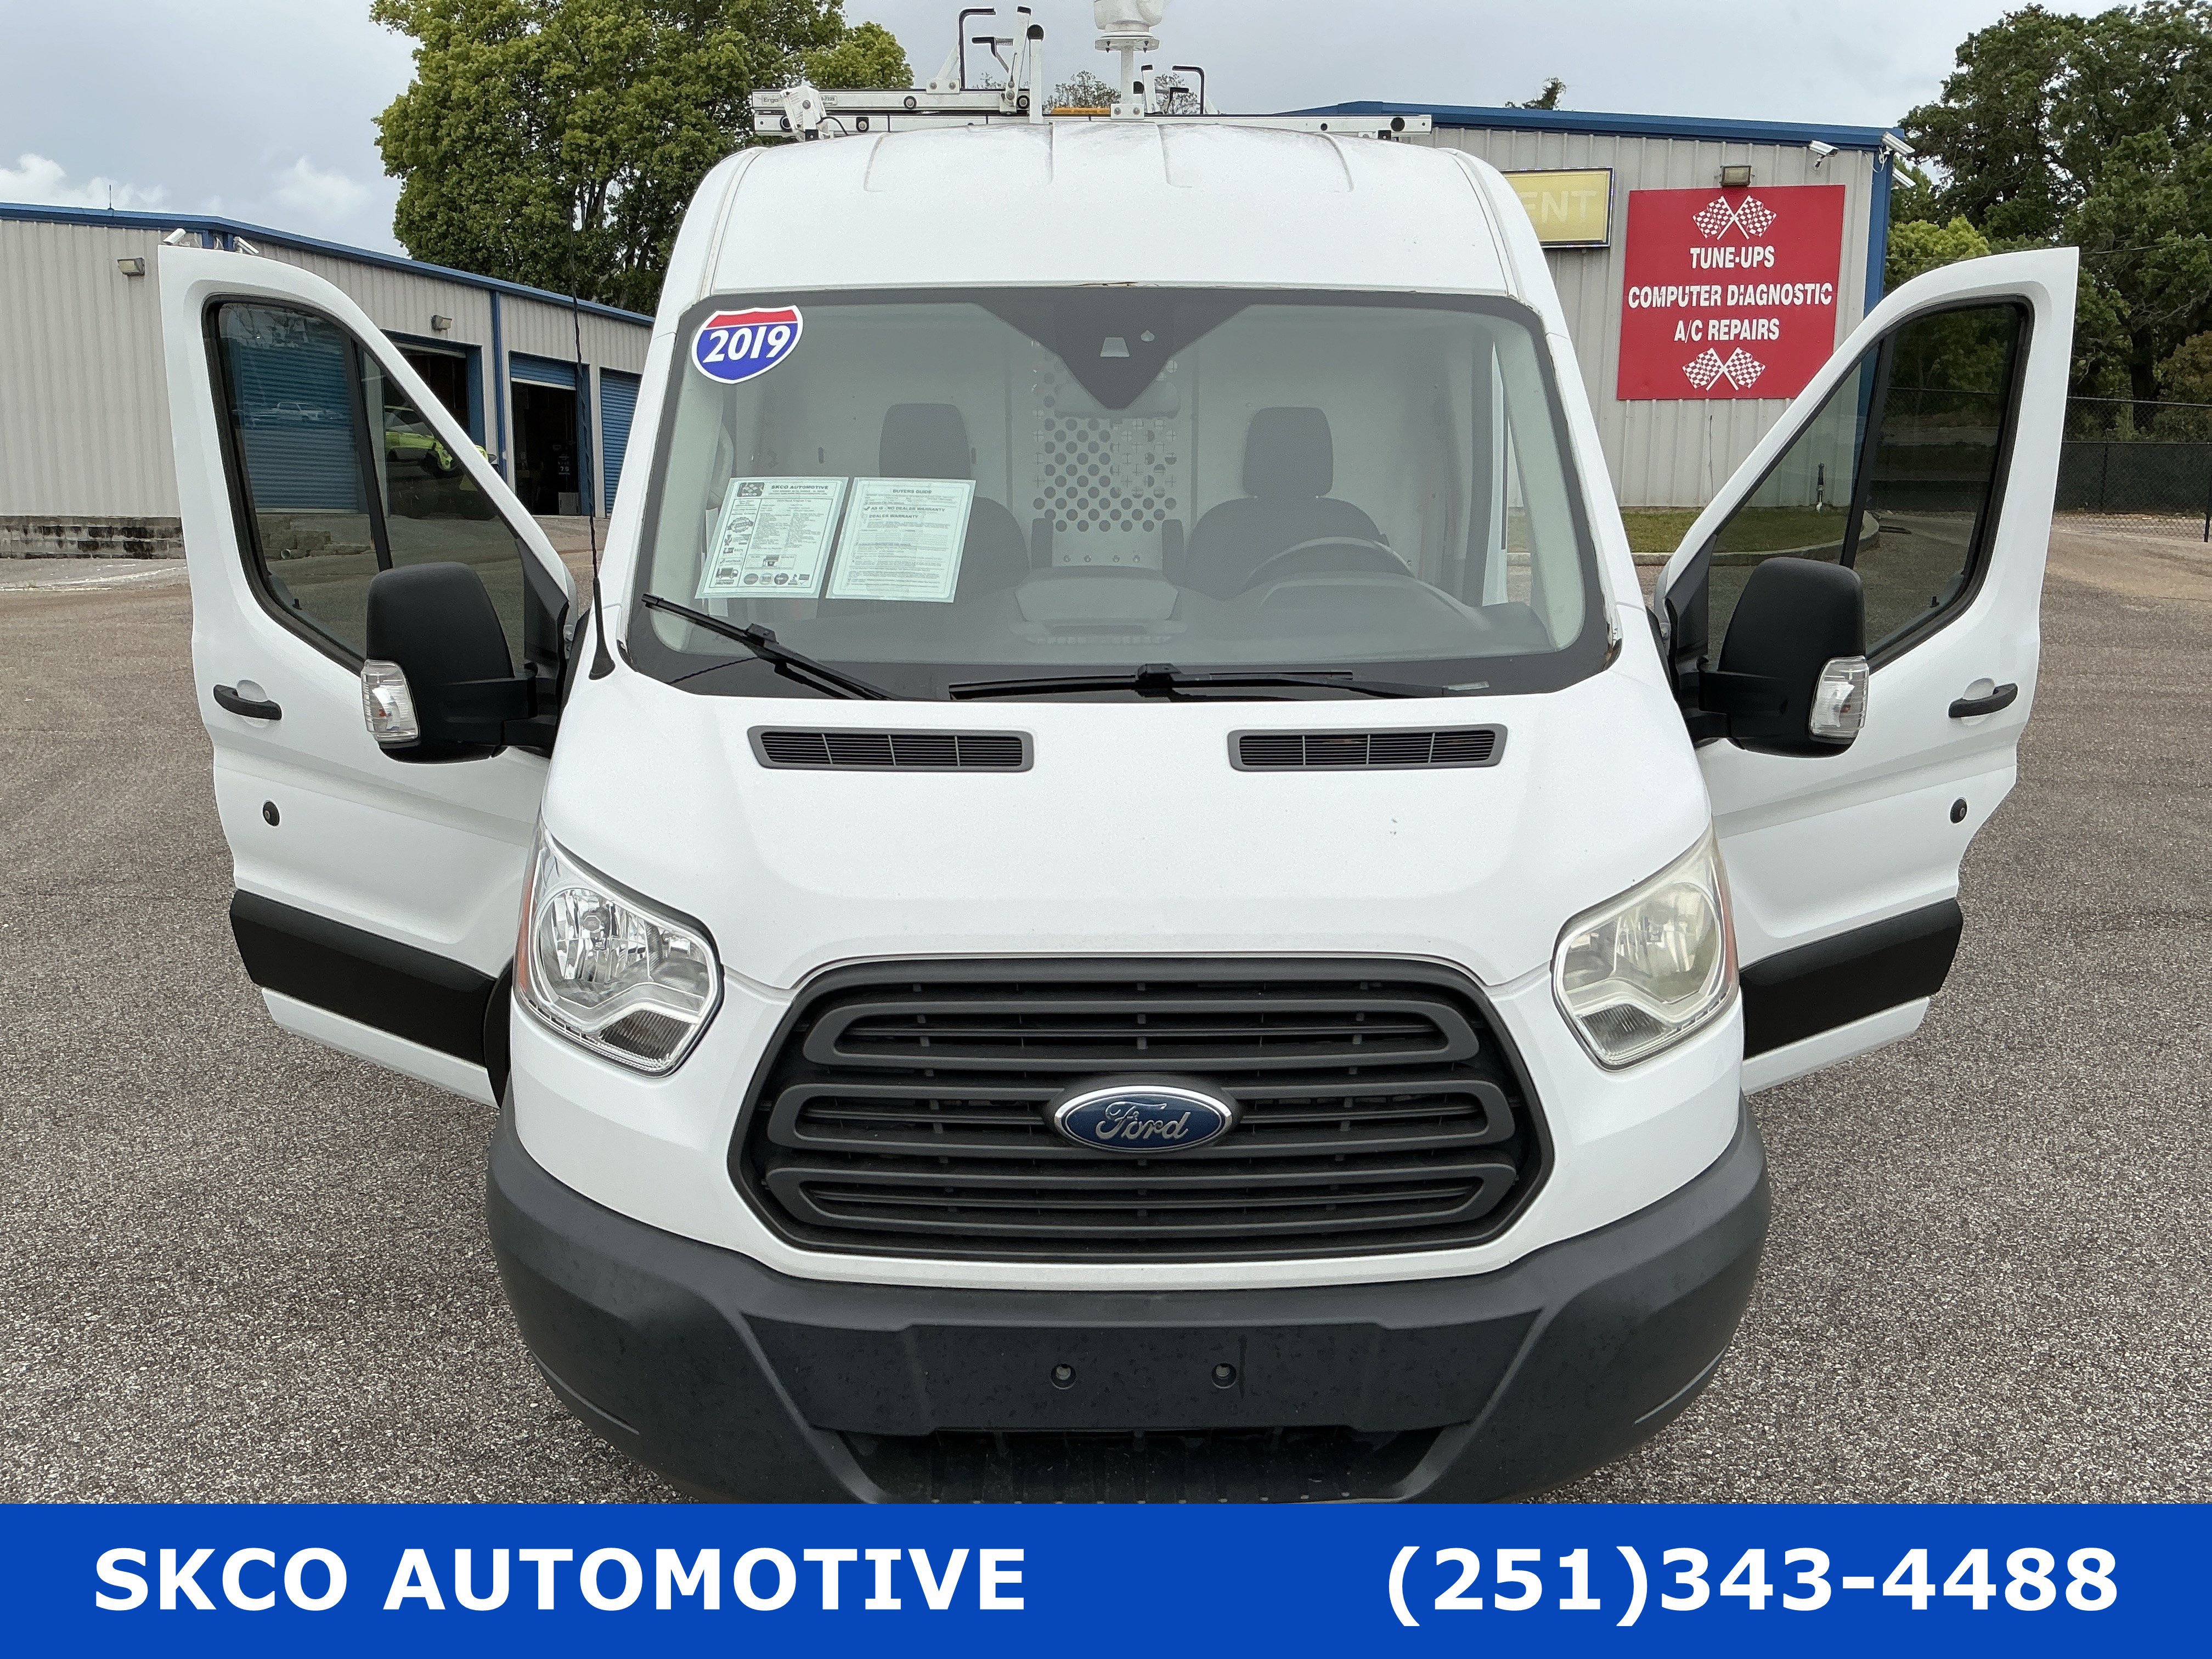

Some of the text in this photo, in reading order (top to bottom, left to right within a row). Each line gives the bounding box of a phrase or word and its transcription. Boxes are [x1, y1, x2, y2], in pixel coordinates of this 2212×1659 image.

[1690, 245, 1775, 269] TUNE-UPS
[1628, 283, 1833, 308] COMPUTER DIAGNOSTIC
[1674, 318, 1780, 343] A/C REPAIRS
[702, 325, 791, 363] 2019
[1096, 1101, 1192, 1140] Ford
